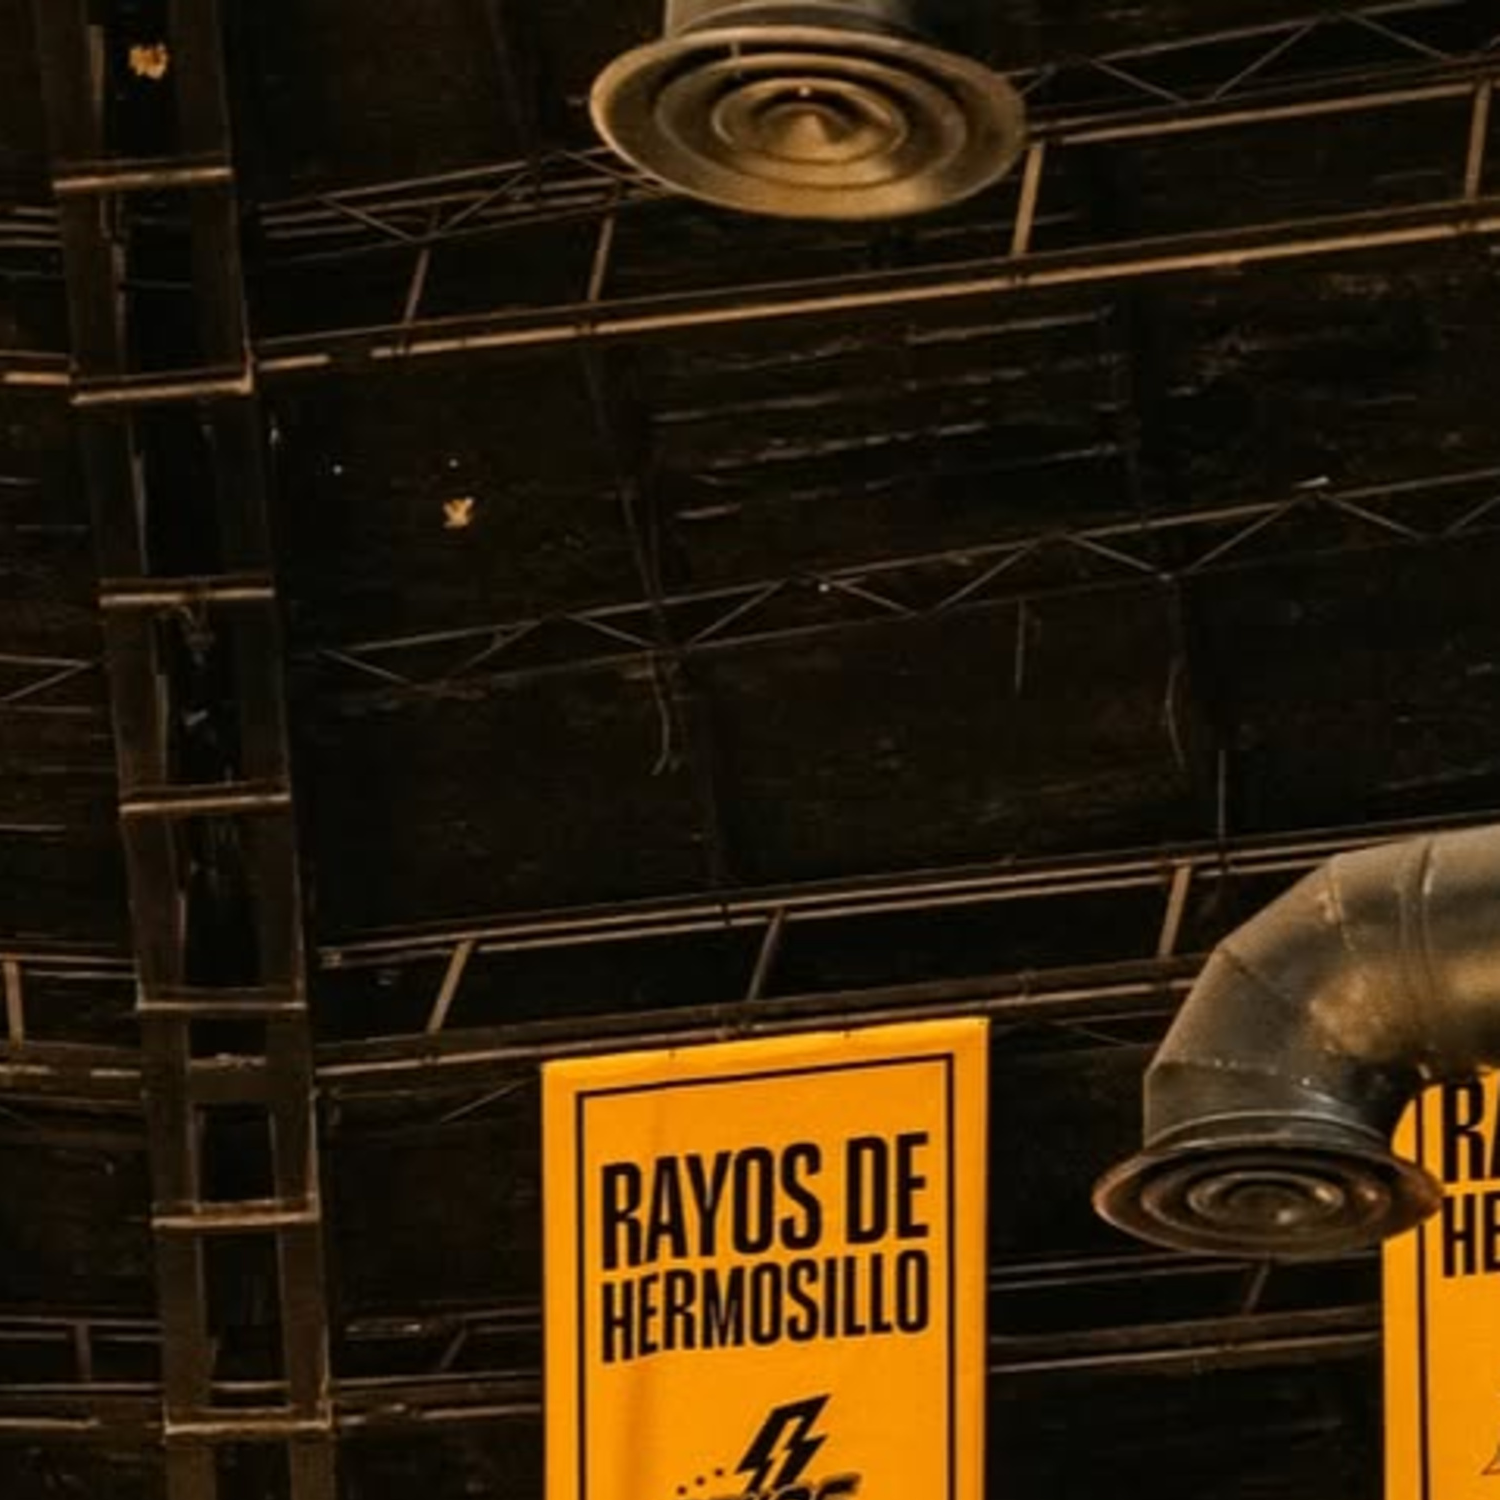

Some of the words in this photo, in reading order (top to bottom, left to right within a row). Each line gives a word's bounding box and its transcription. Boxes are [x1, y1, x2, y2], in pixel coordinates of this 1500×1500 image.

[1443, 1078, 1500, 1182] R
[601, 1142, 822, 1271] RAYOS
[846, 1132, 930, 1245] DE
[601, 1248, 930, 1364] HERMOSILLO
